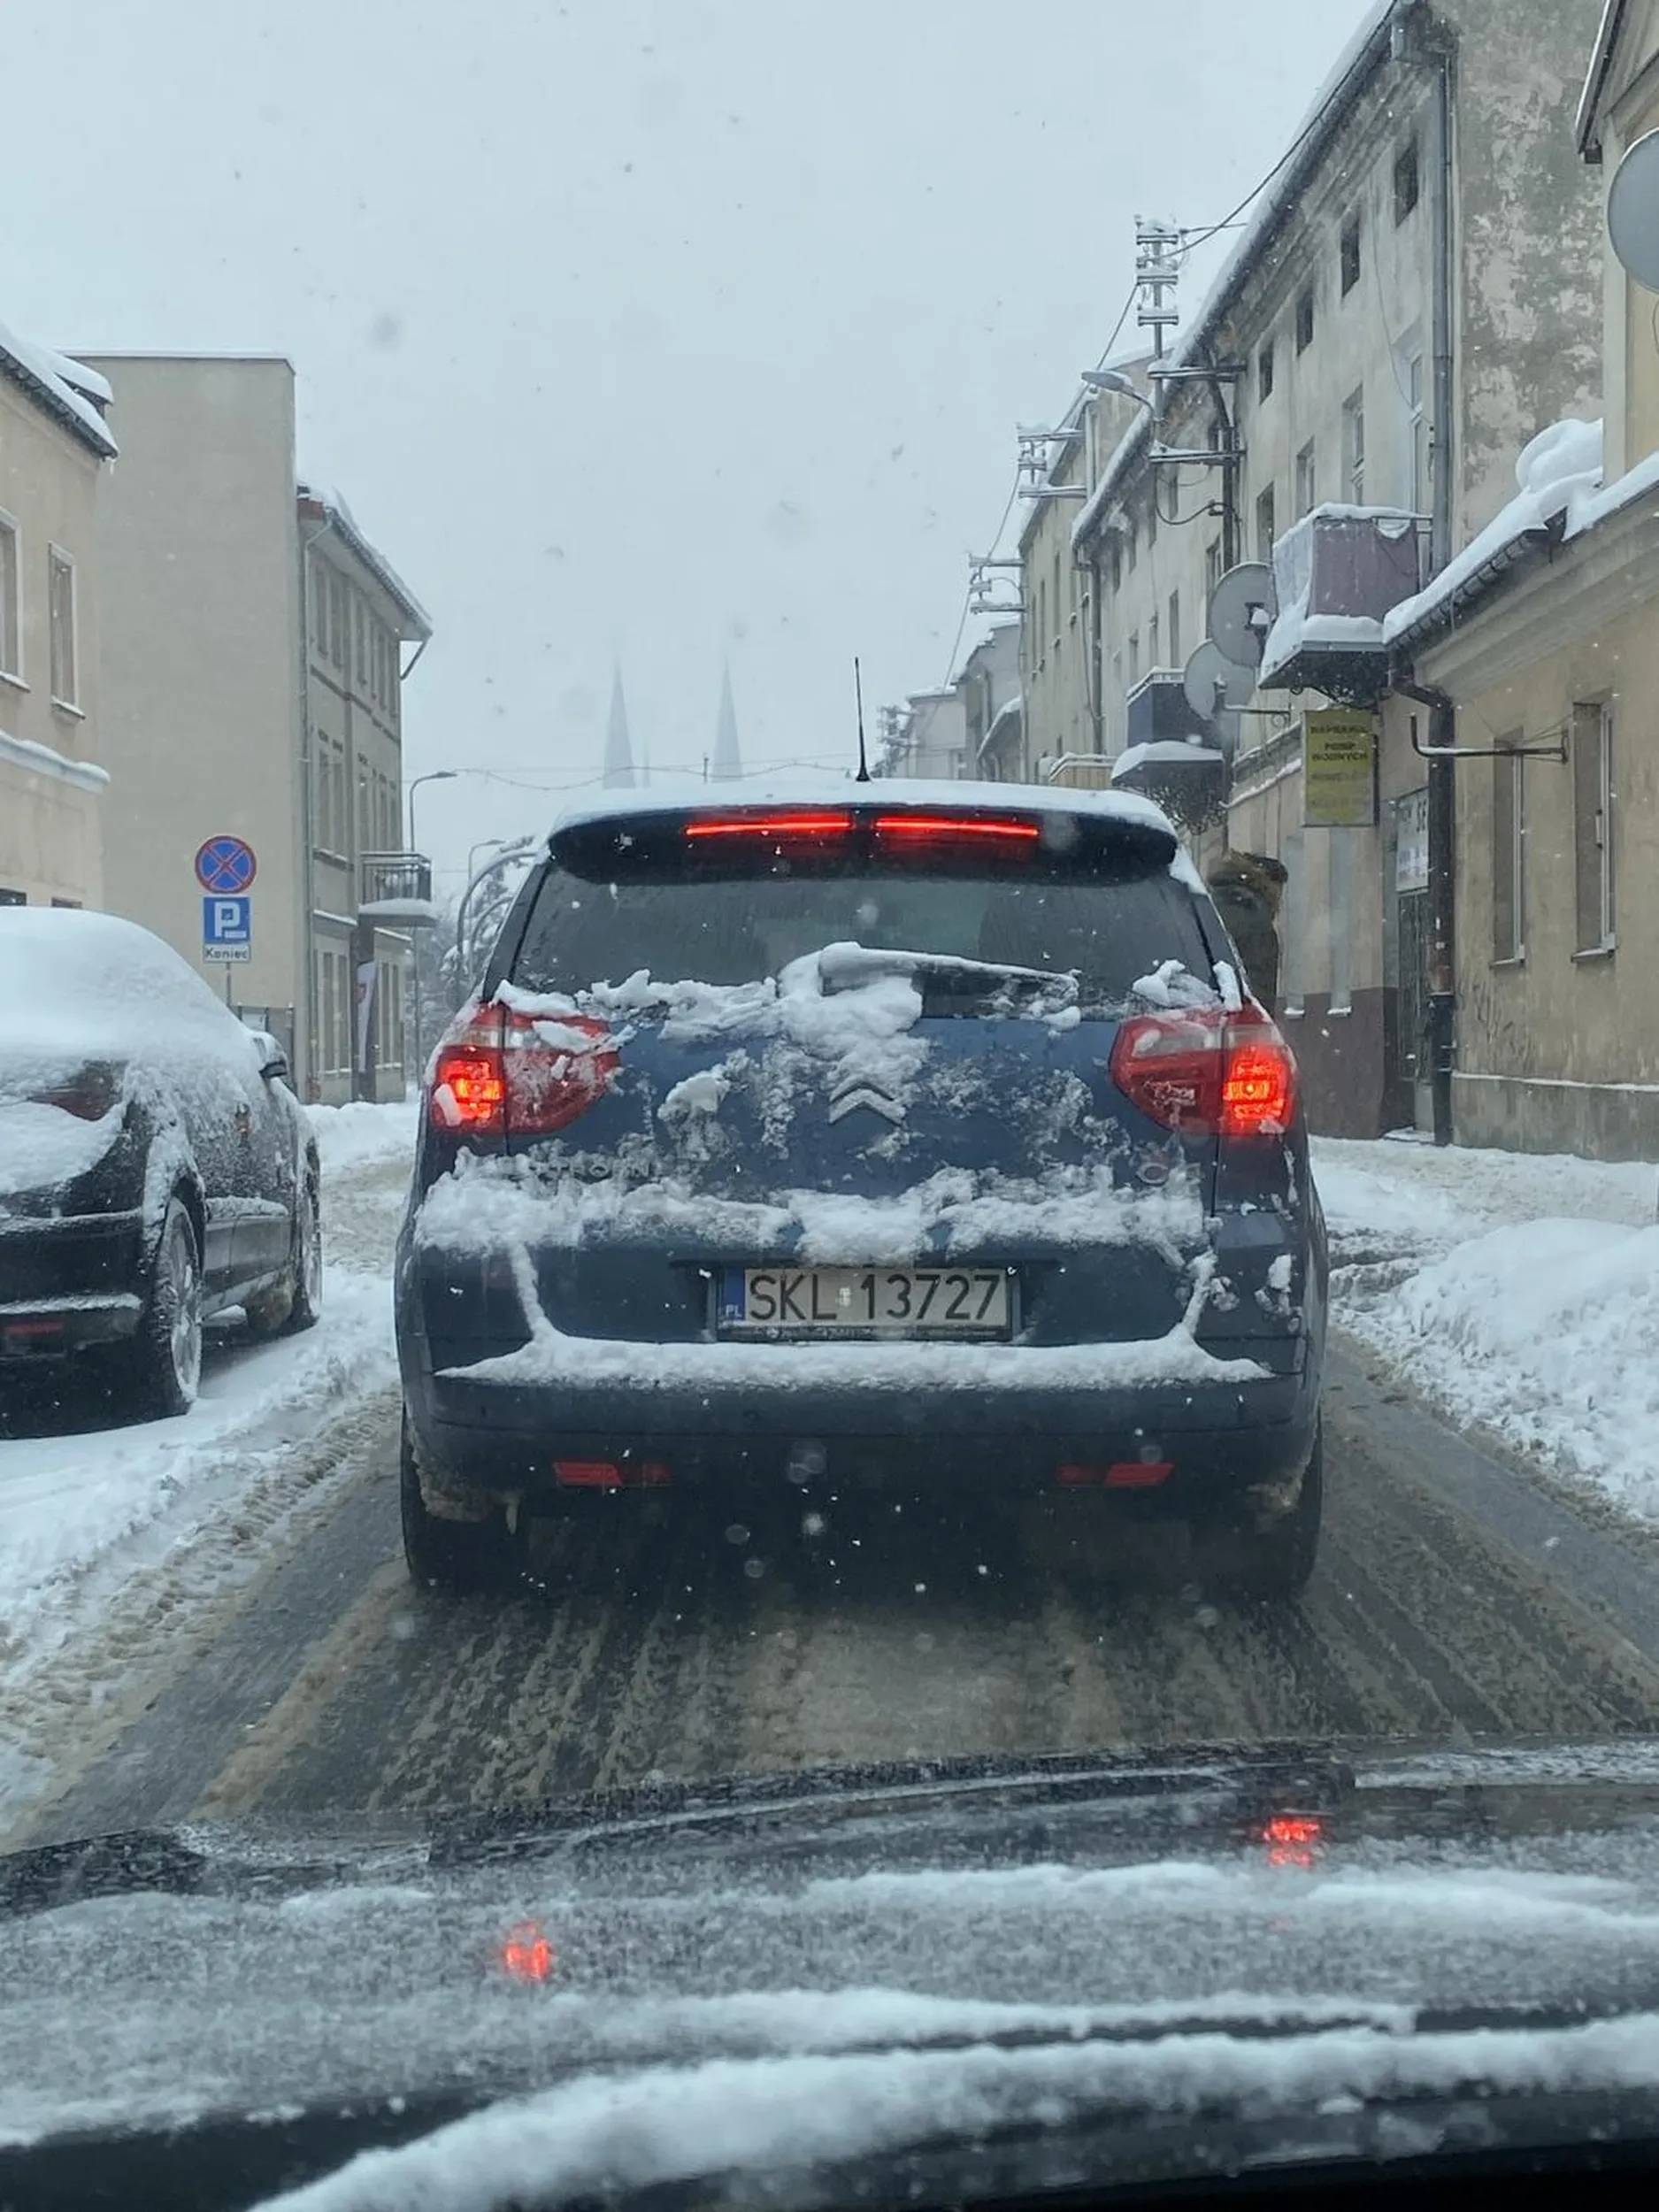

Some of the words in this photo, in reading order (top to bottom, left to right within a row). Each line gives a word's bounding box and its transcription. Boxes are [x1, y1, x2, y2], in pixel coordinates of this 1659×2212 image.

[205, 947, 248, 959] Koniec
[749, 1274, 837, 1320] SKL
[860, 1274, 1001, 1320] 13727
[726, 1303, 742, 1318] PL
